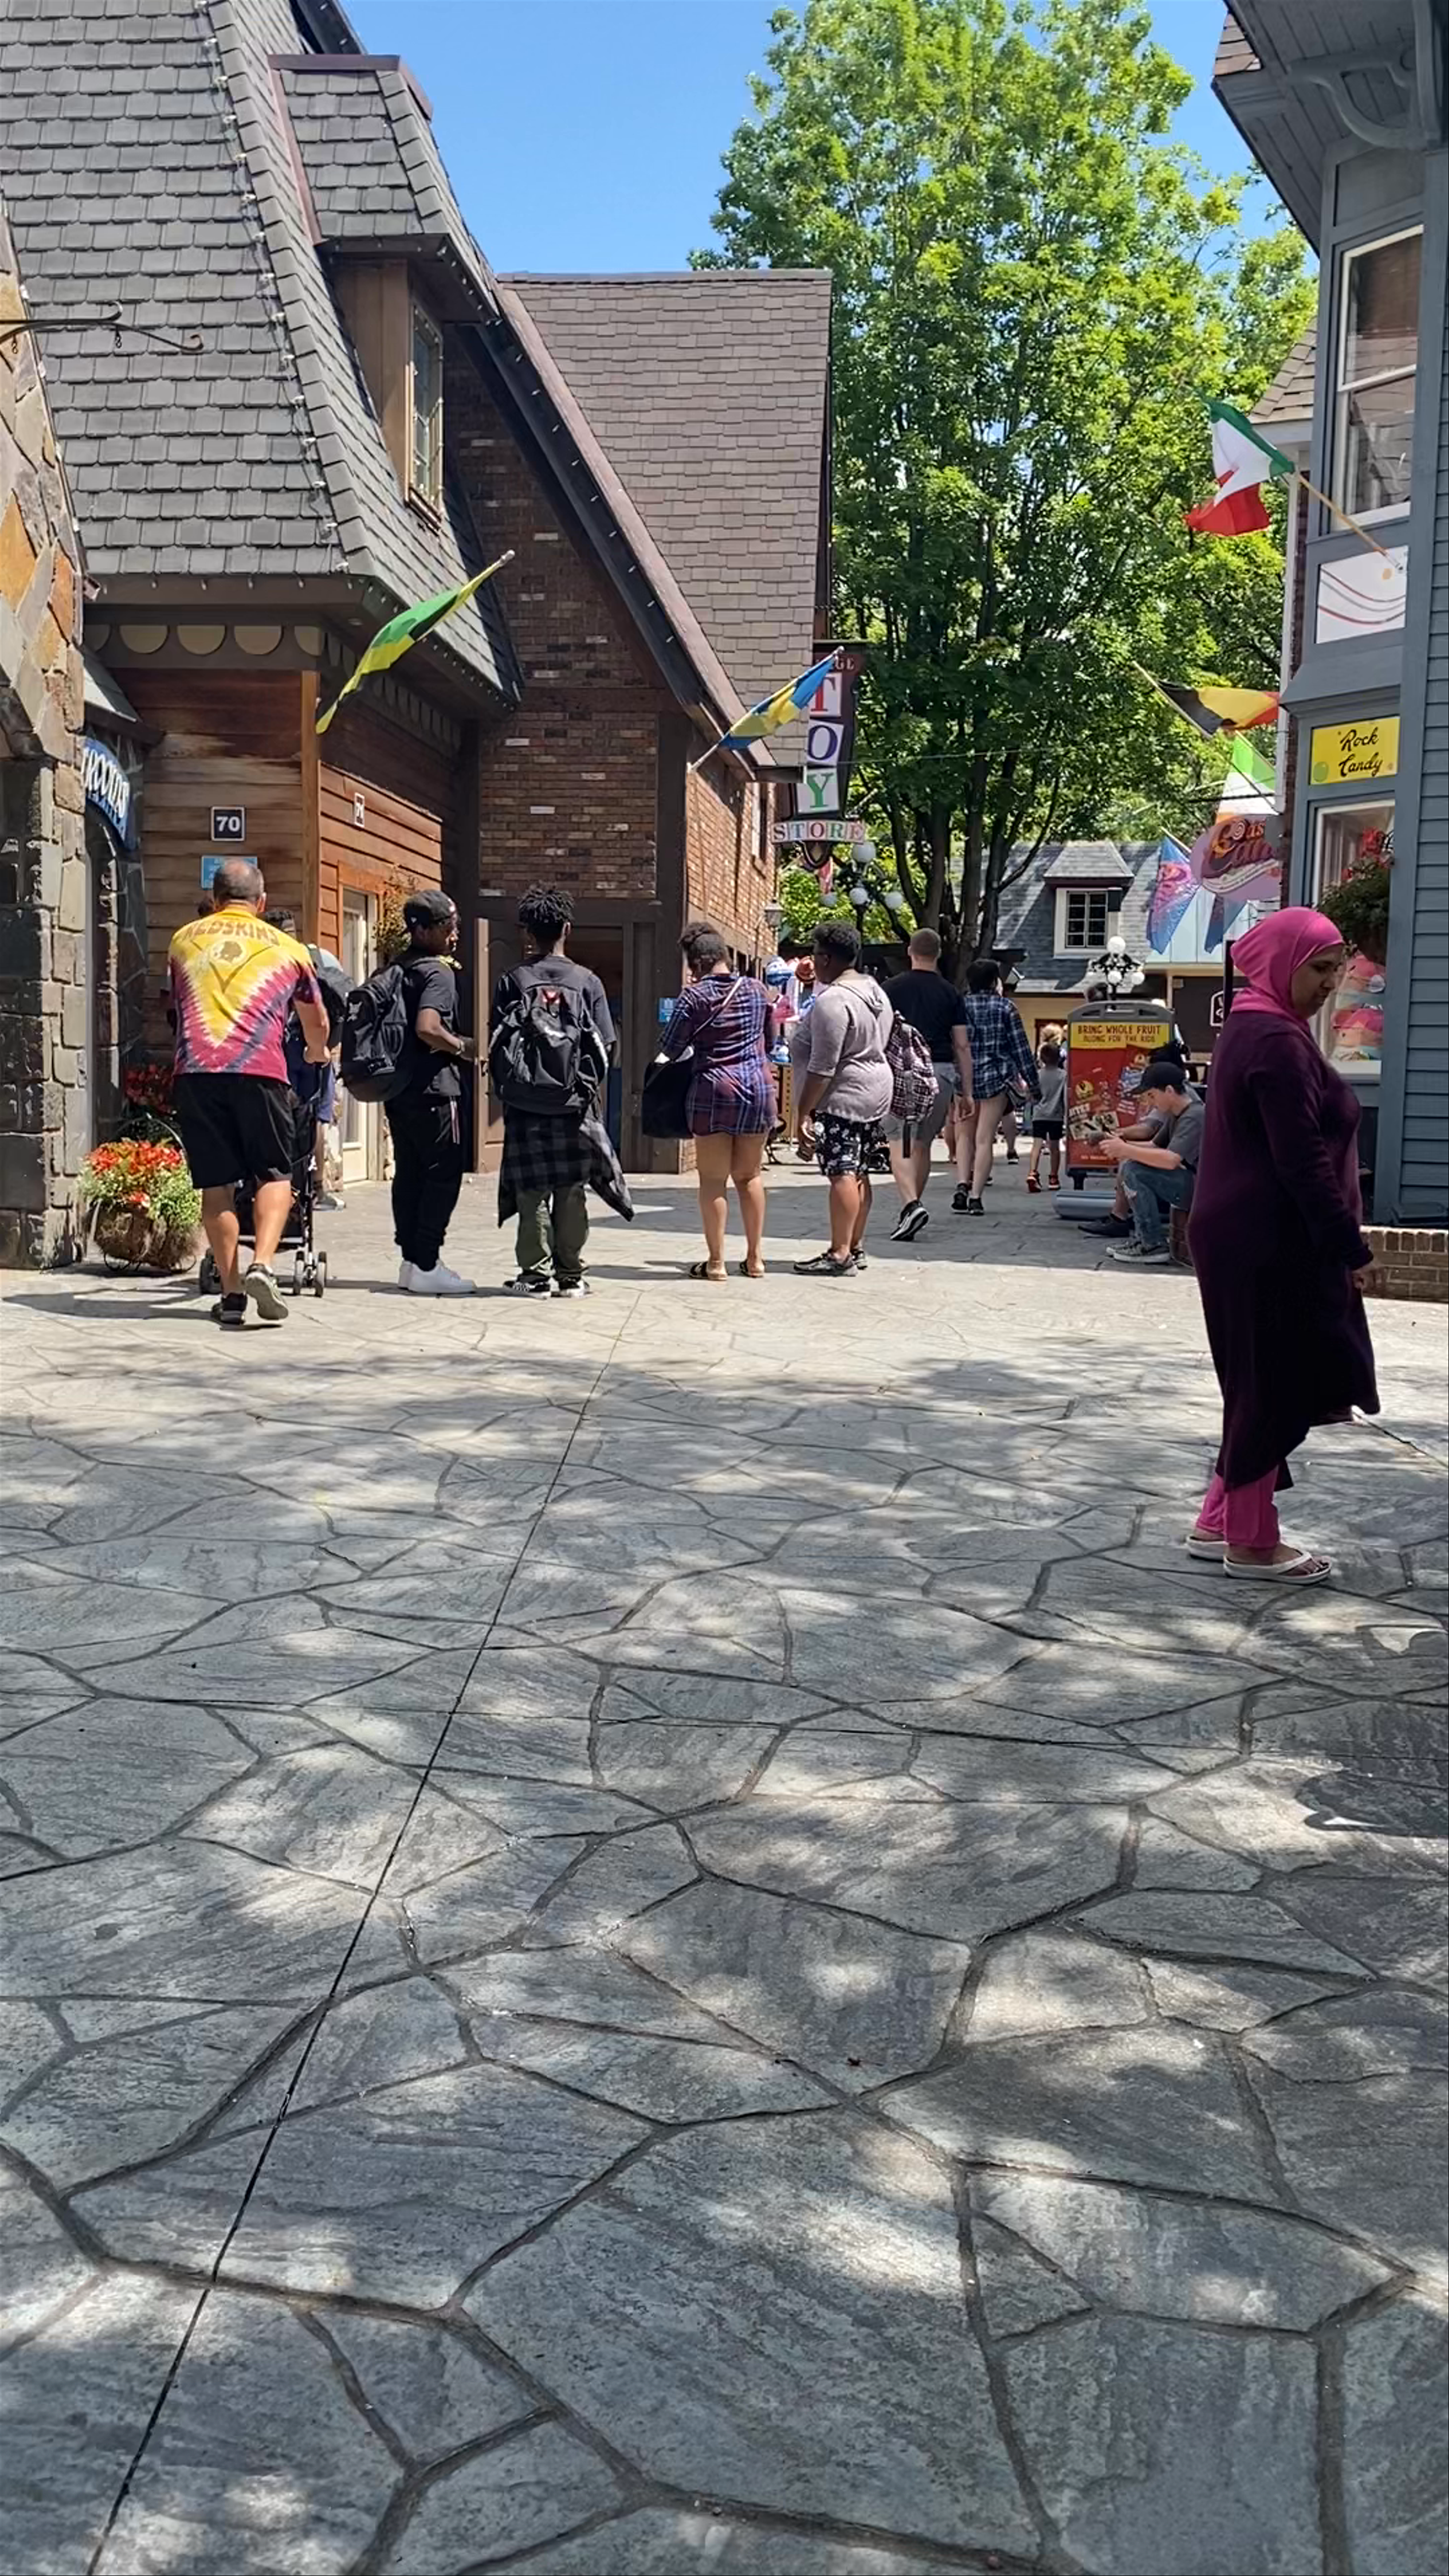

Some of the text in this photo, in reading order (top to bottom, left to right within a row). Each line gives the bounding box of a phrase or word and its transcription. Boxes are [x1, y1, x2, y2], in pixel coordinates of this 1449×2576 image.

[1340, 727, 1379, 752] Rock
[1338, 752, 1383, 777] Candy
[216, 816, 240, 832] 70
[774, 821, 863, 841] STORE
[181, 920, 280, 946] REDSKINS
[1078, 1024, 1161, 1035] BRING WHOLE FRUIT
